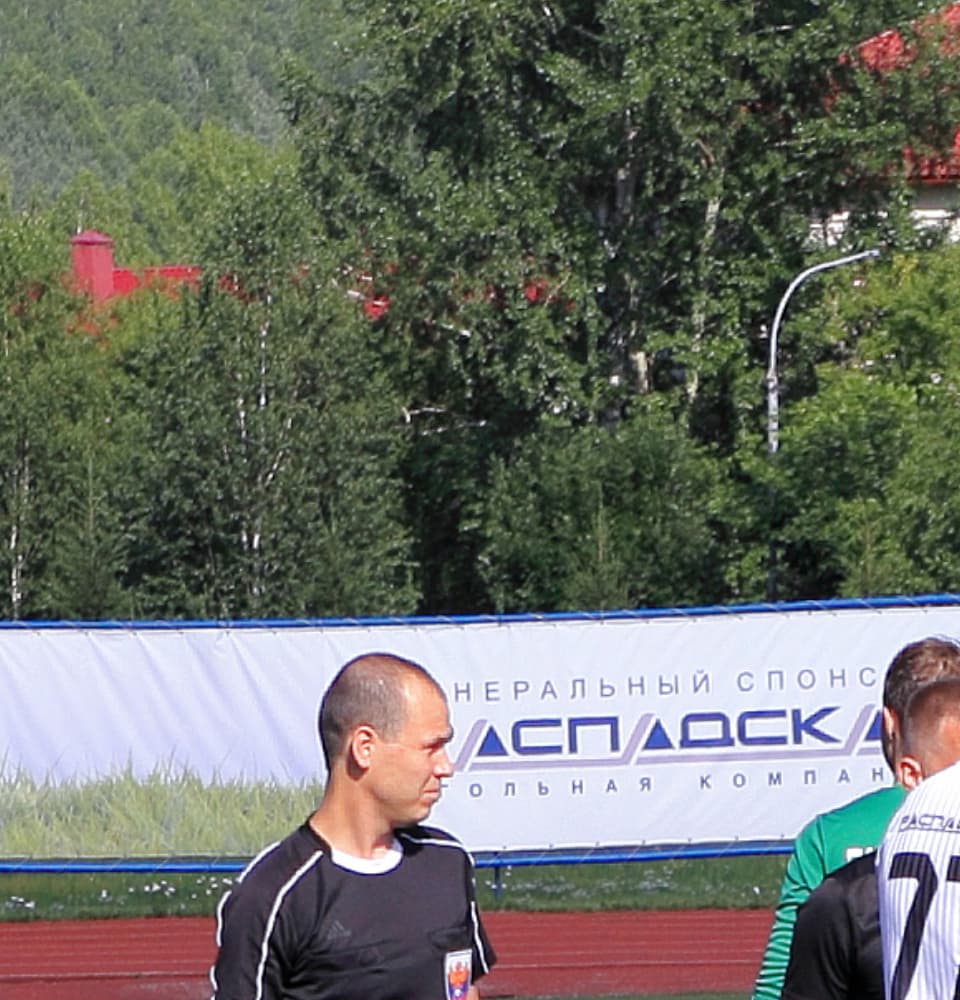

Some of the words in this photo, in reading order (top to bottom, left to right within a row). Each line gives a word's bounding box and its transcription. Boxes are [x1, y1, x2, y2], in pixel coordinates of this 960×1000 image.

[454, 669, 710, 702] НЕРАЛЬНЫЙ
[736, 666, 877, 693] СПОНС
[456, 704, 882, 770] АСПАДСКА
[441, 776, 652, 798] ОЛЬНАЯ
[699, 766, 885, 790] КОМПАН
